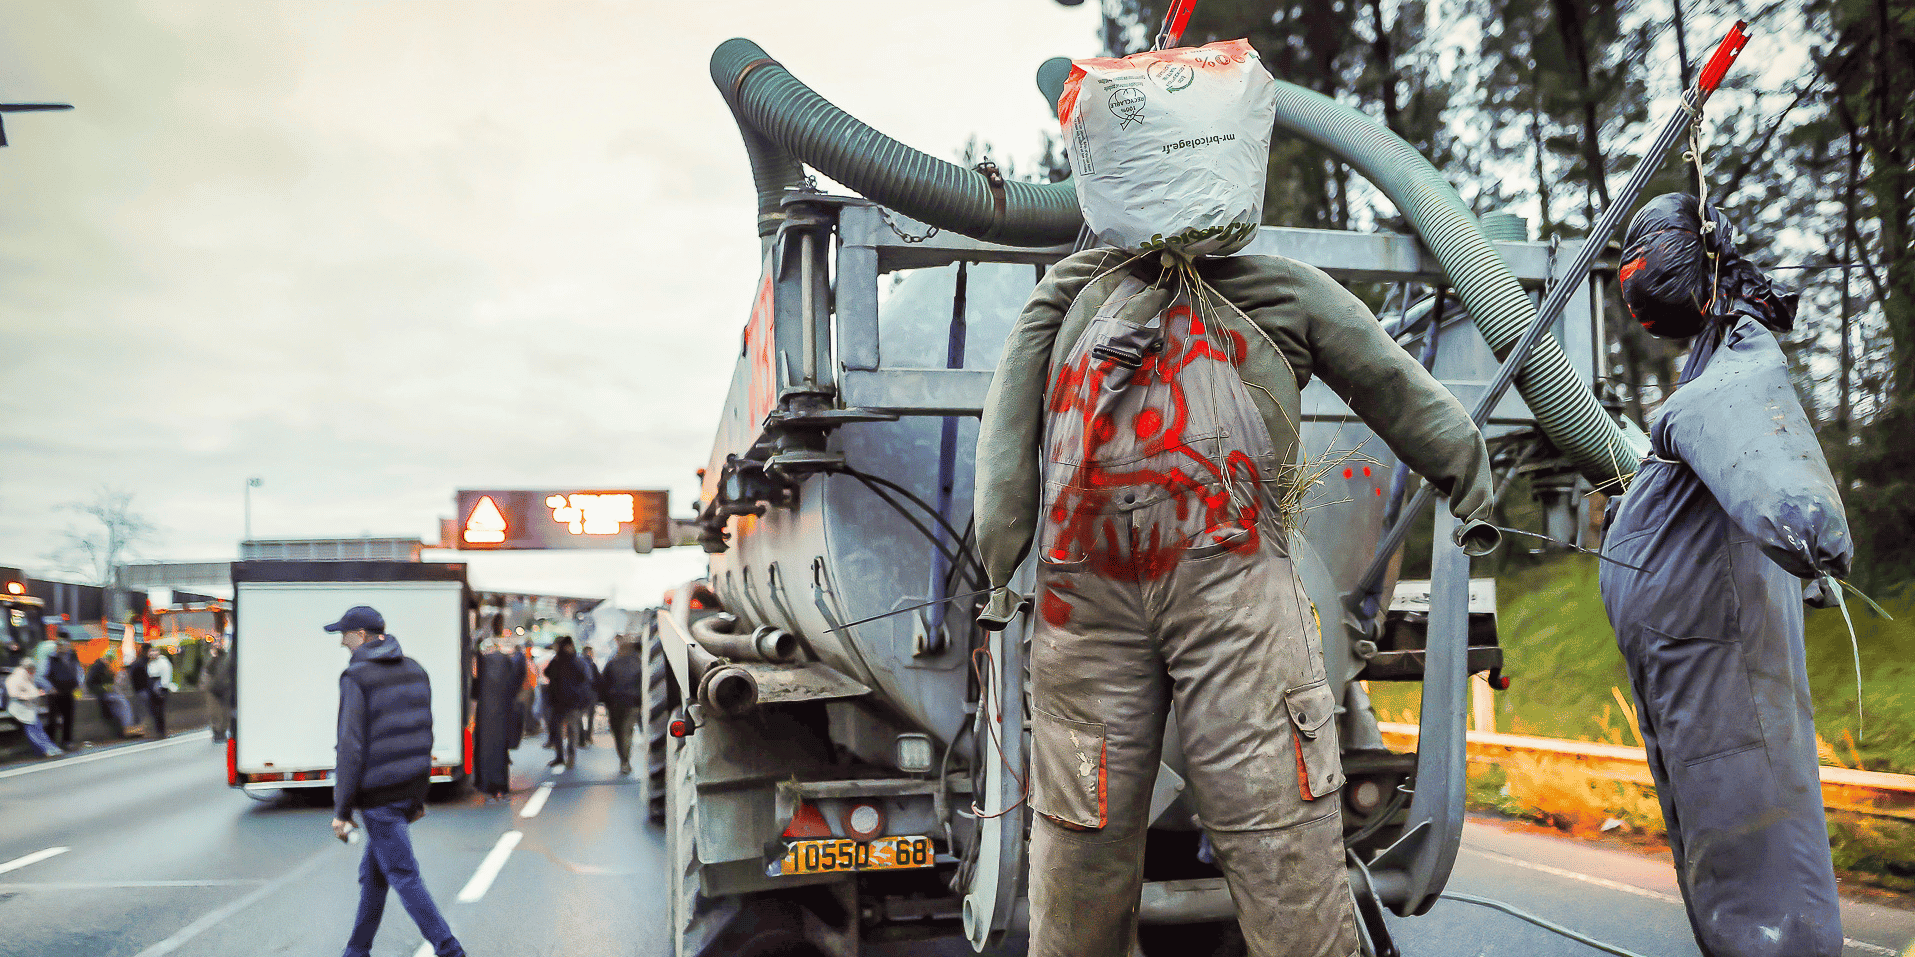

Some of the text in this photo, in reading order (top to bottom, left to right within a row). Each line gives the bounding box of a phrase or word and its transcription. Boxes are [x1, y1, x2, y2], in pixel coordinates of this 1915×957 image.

[1110, 97, 1145, 109] RECYCLABLE
[1161, 134, 1236, 155] mr-bricolage.fr
[895, 839, 926, 865] 68
